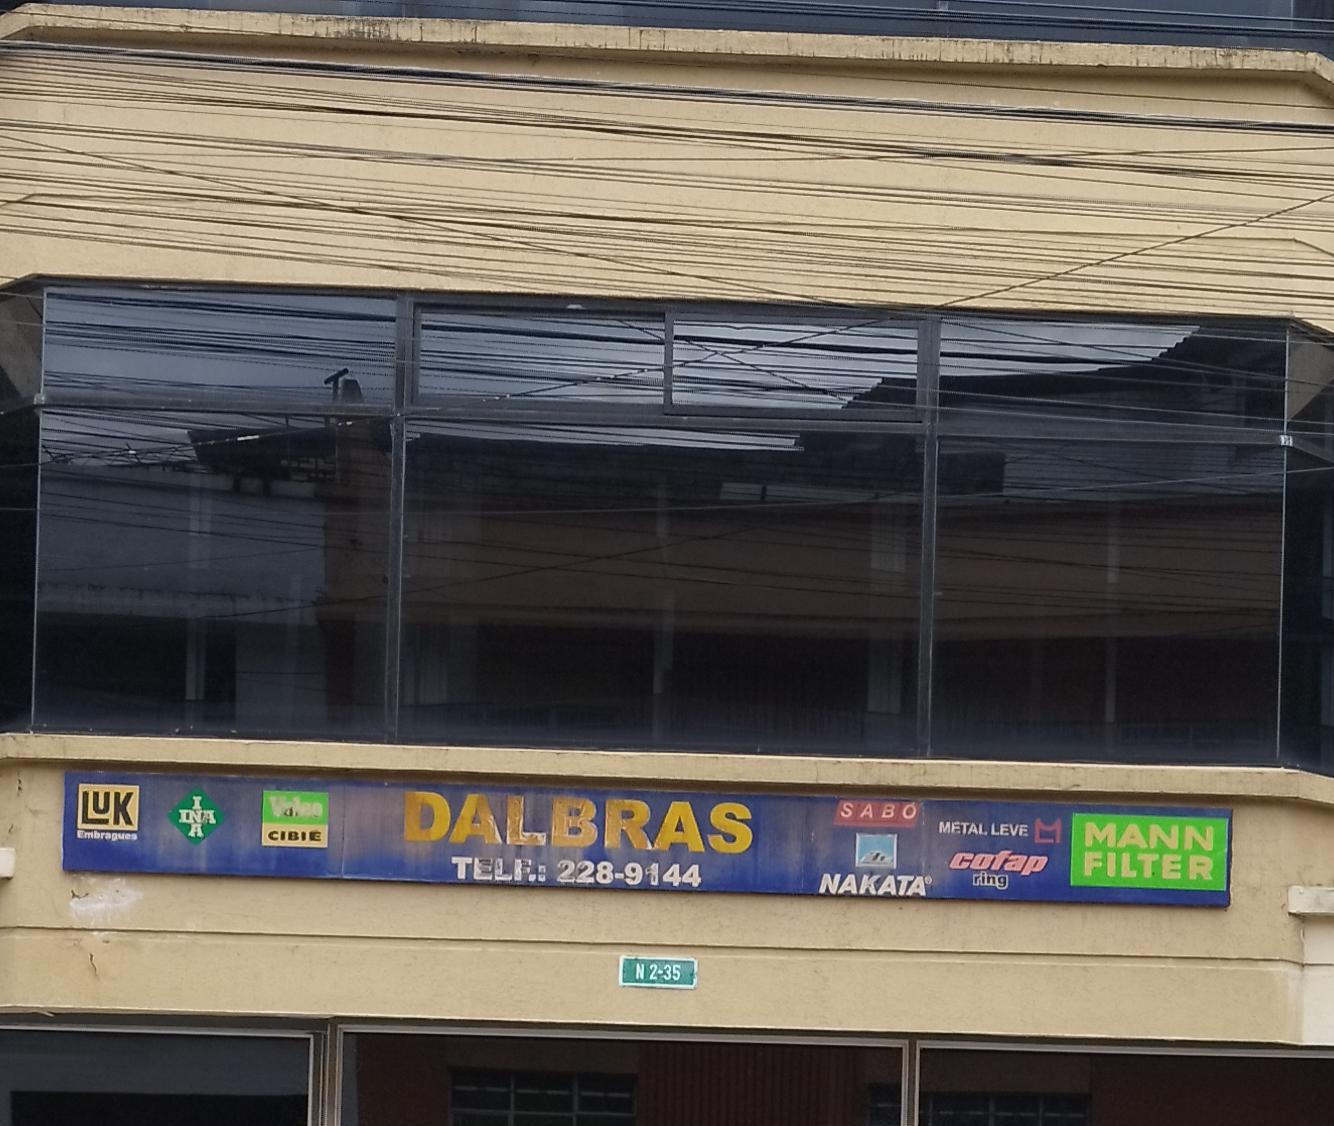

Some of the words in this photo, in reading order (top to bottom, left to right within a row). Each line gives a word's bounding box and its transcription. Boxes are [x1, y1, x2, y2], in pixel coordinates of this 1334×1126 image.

[77, 830, 138, 841] Embragues
[404, 791, 753, 854] DALBRAS
[938, 821, 987, 836] METAL
[991, 823, 1029, 837] LEVE
[1084, 821, 1213, 850] MANN
[557, 860, 702, 887] 228-9144
[949, 850, 1049, 876] cofap
[1083, 852, 1213, 880] FILTER
[972, 871, 1008, 890] ring
[635, 963, 644, 980] N
[649, 964, 681, 981] 2-35
